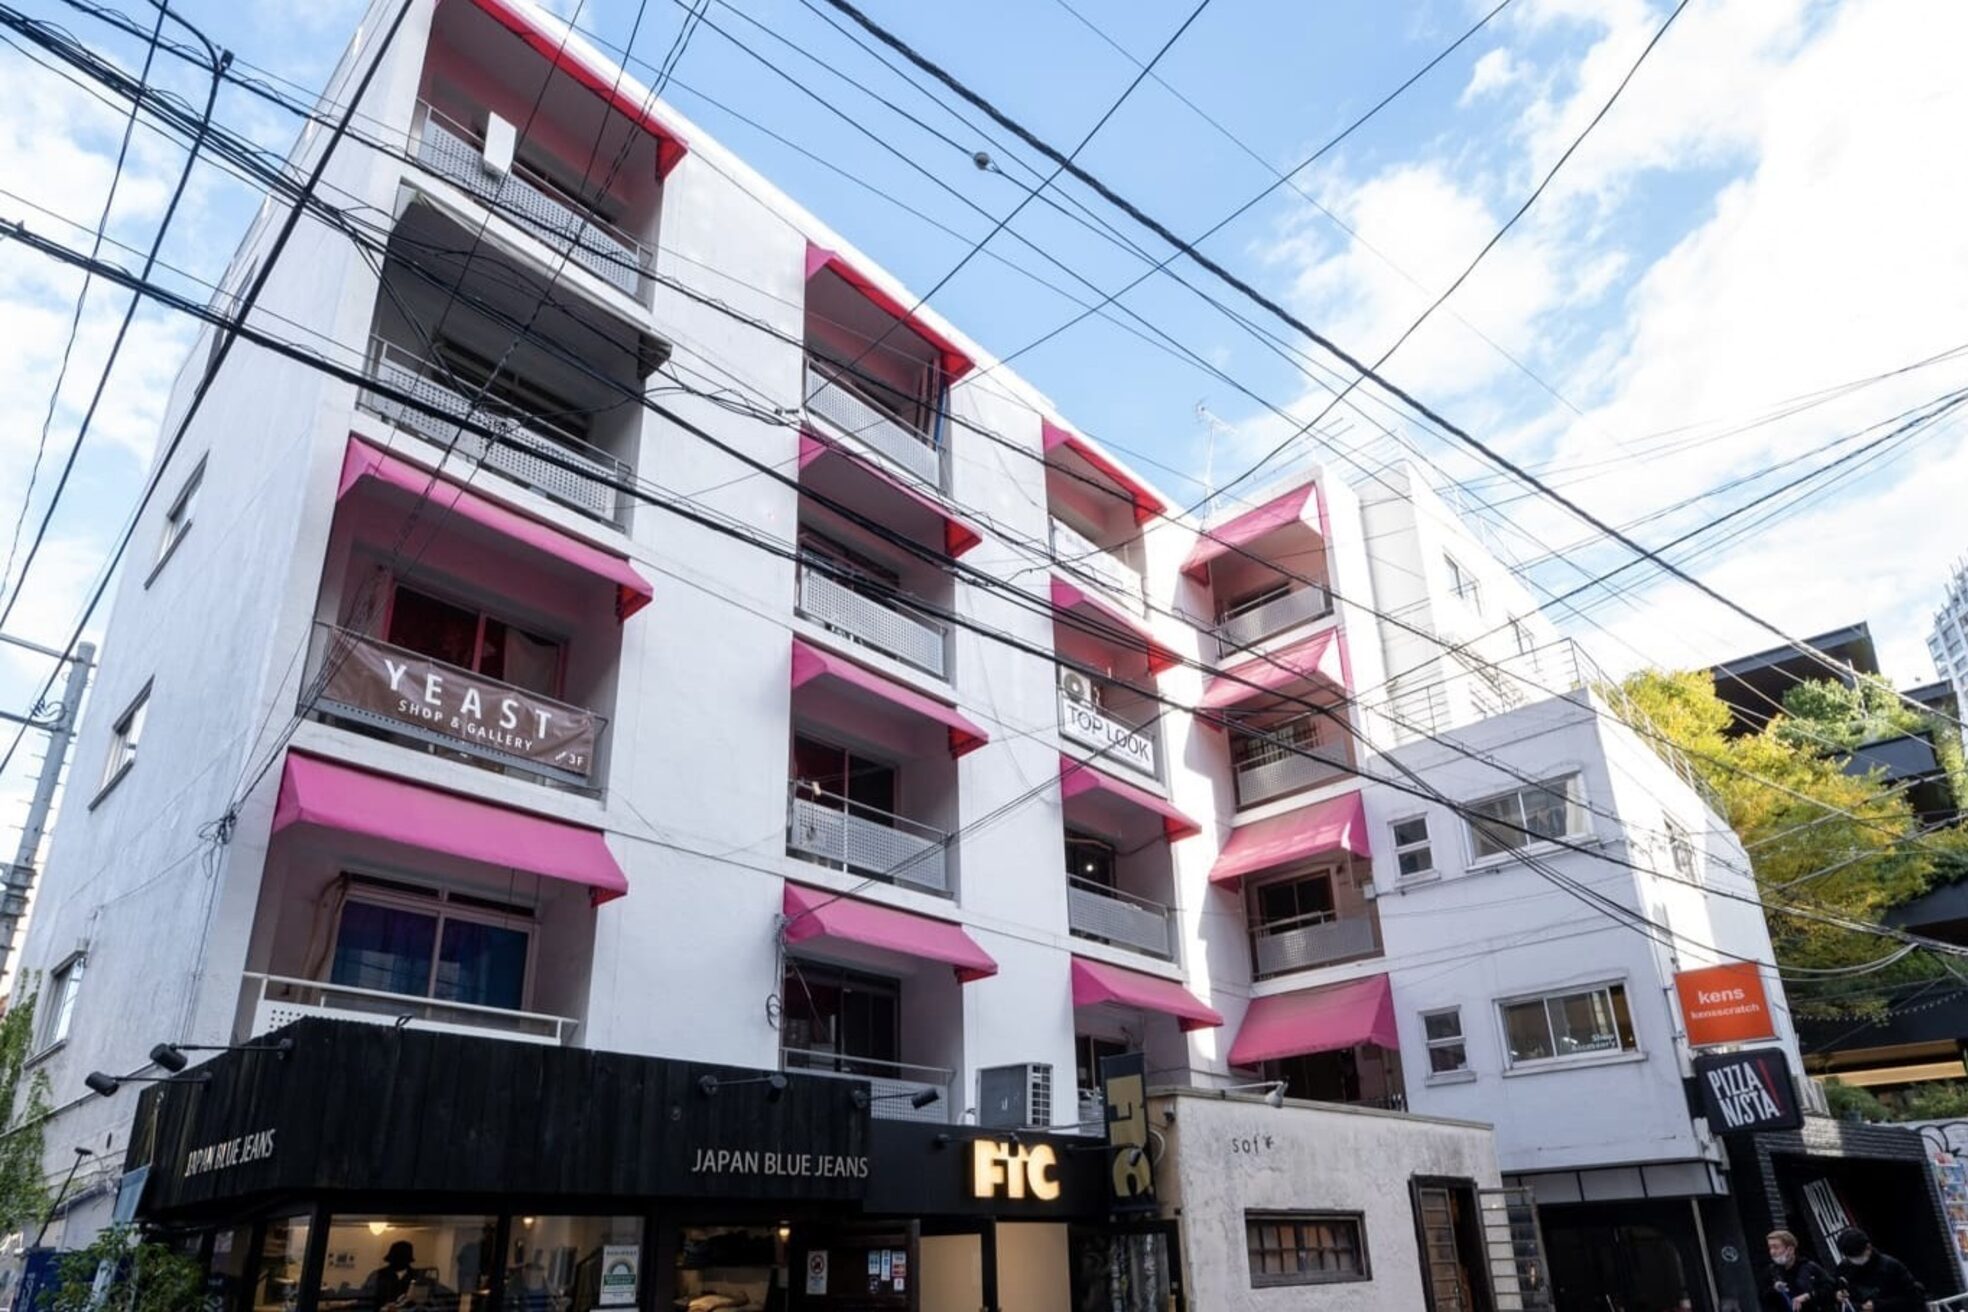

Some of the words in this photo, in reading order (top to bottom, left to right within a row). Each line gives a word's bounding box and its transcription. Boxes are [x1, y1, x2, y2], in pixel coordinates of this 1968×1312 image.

[383, 659, 552, 740] YEAST
[398, 699, 444, 723] SHOP
[450, 716, 460, 729] &
[467, 722, 533, 751] GALLERY
[1066, 702, 1103, 735] TOP
[1106, 722, 1151, 763] LOOK
[1697, 988, 1745, 1005] kens
[1706, 1061, 1763, 1101] PIZZA
[184, 1144, 217, 1177] JAPAN
[213, 1137, 242, 1170] BLUE
[239, 1128, 276, 1164] JEANS
[692, 1148, 759, 1174] JAPAN
[763, 1152, 812, 1176] BLUE
[814, 1154, 869, 1179] JEANS
[974, 1138, 1061, 1201] FTC
